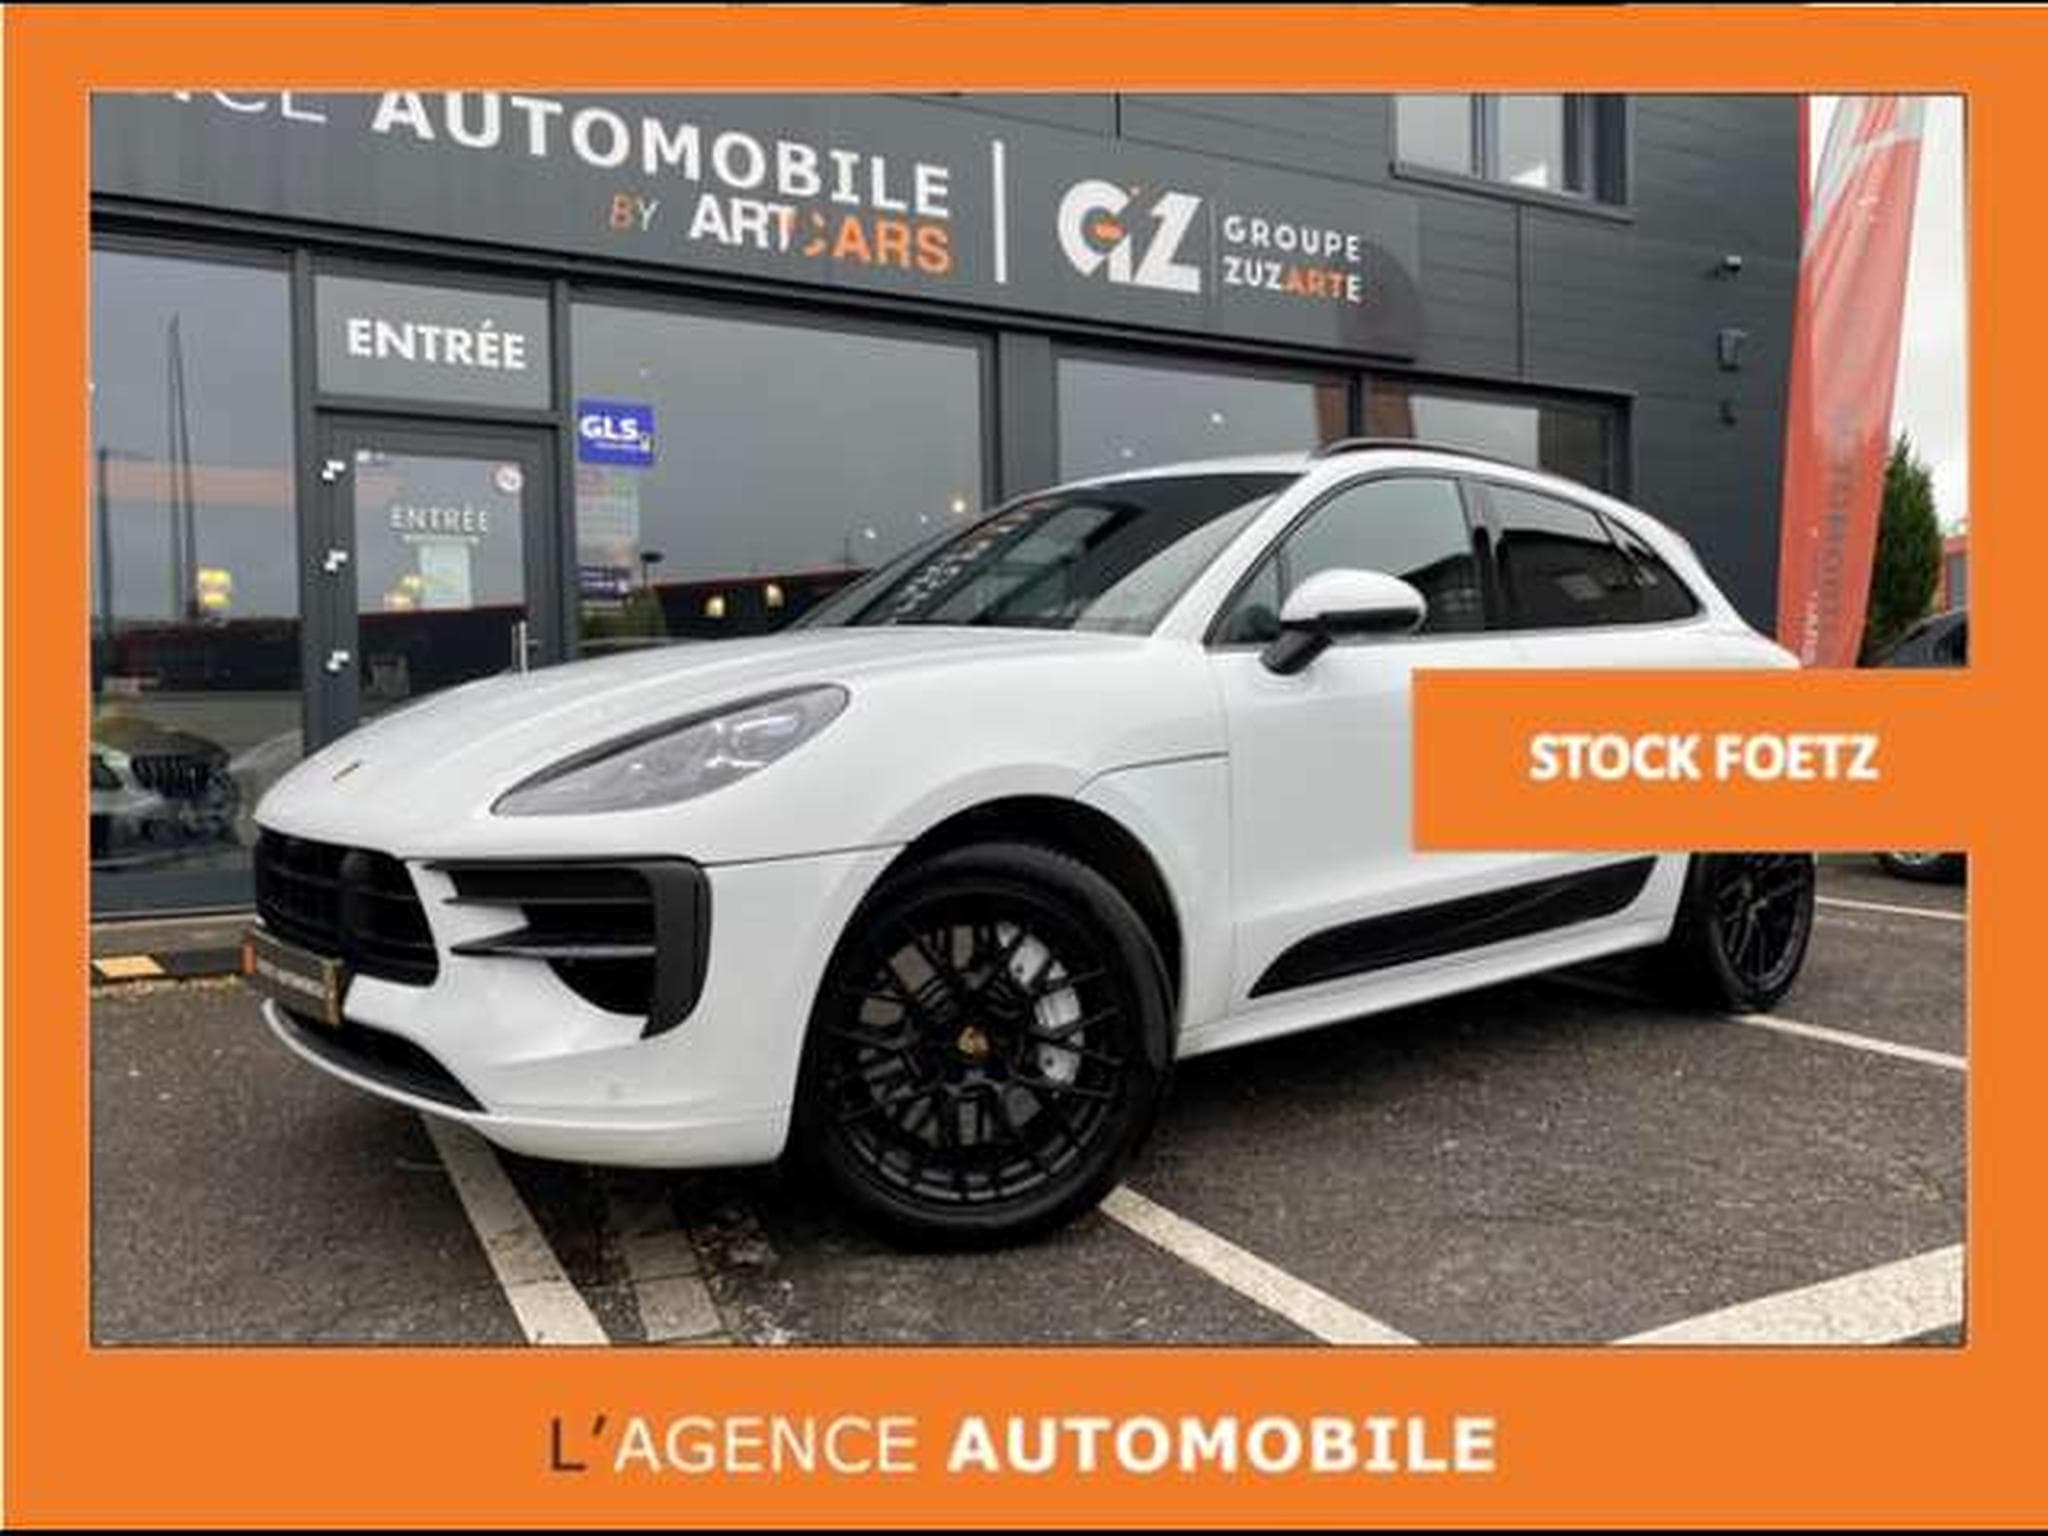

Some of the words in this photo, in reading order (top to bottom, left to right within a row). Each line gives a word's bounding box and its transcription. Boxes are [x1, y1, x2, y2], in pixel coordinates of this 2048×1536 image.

[371, 89, 951, 217] AUTOMOBILE
[610, 193, 660, 232] BY
[1223, 214, 1362, 261] GROUPE
[1222, 256, 1363, 303] ZUZARTE
[346, 318, 527, 371] ENTRÉE
[579, 414, 640, 442] GLS
[390, 503, 489, 533] ENTRÉE
